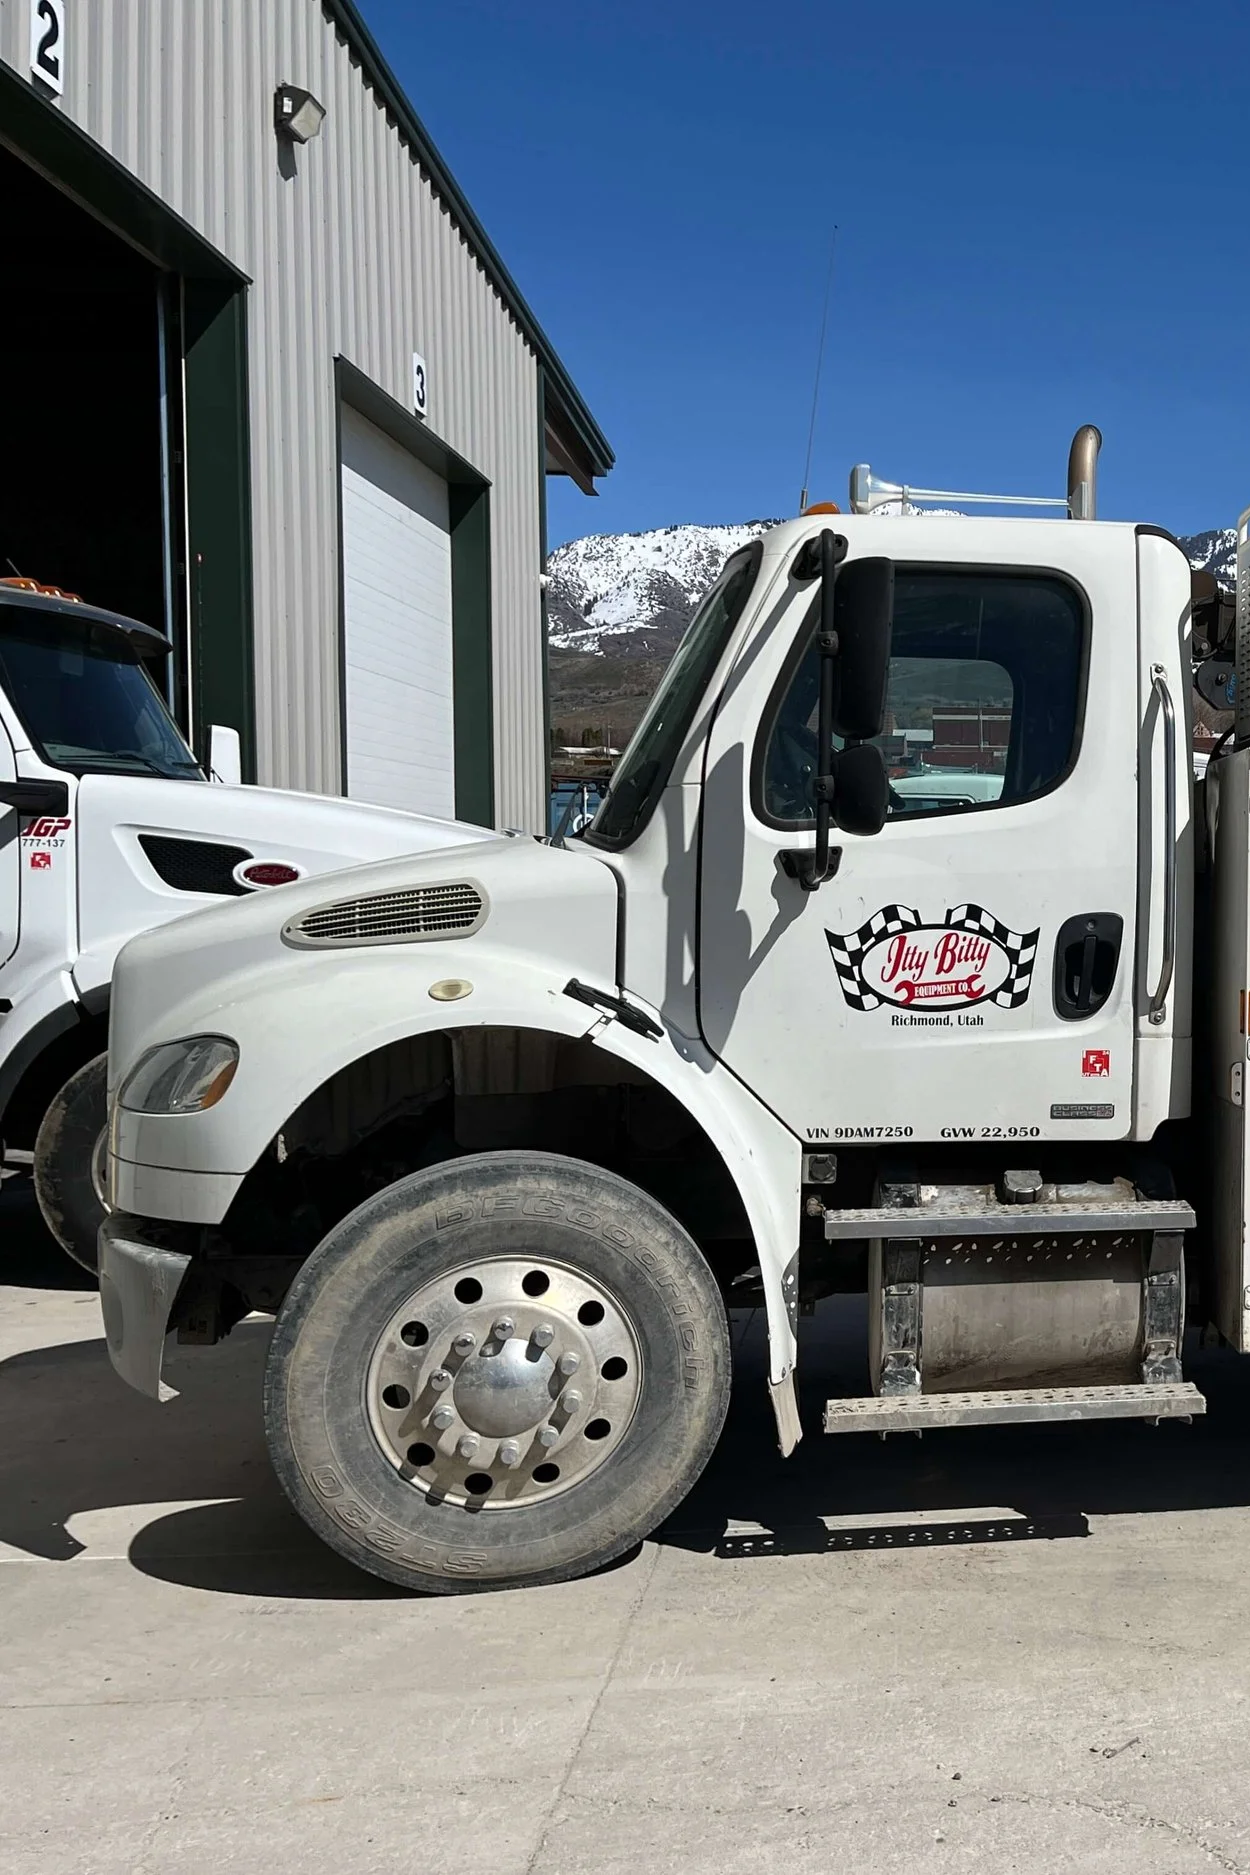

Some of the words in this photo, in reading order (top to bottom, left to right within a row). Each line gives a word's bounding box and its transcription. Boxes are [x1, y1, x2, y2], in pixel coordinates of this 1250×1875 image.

[37, 0, 59, 80] 2
[416, 365, 425, 408] 3
[22, 839, 65, 848] 777-137
[881, 935, 929, 982] Itty
[934, 933, 991, 975] Bitty
[914, 983, 957, 997] EQUIPMENT
[958, 982, 971, 993] CO.
[891, 1015, 953, 1027] Richmond,
[958, 1015, 984, 1026] Utah
[806, 1127, 830, 1139] VIN
[834, 1126, 914, 1139] 9DAM7250
[940, 1128, 976, 1139] GVW
[981, 1127, 1041, 1139] 22,950
[434, 1194, 705, 1391] BFGoodrich
[311, 1464, 488, 1574] ST230
